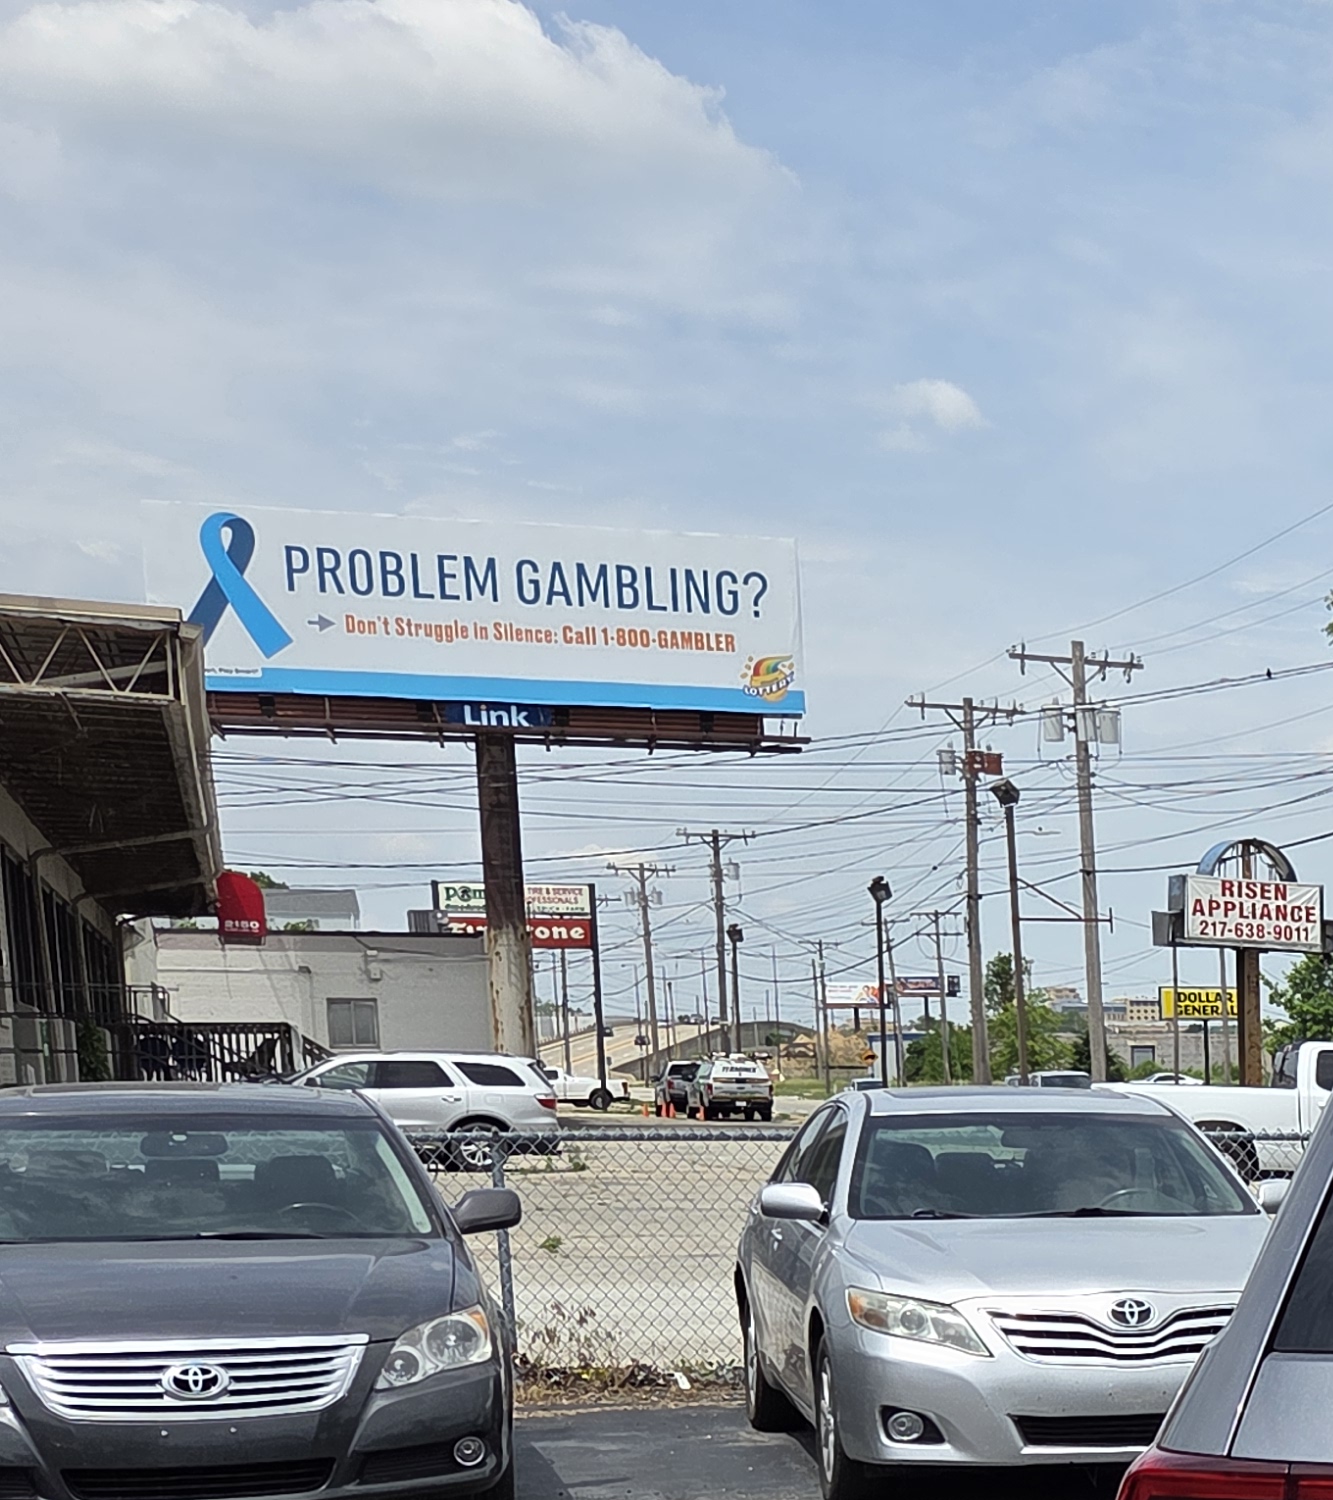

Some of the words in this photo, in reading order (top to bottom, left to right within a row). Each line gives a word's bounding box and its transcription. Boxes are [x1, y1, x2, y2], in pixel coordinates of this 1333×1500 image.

[284, 545, 499, 602] PROBLEM
[515, 559, 768, 619] GAMBLING?
[345, 614, 390, 635] Don't
[395, 617, 469, 643] Struggle
[493, 622, 558, 644] Silence:
[562, 625, 597, 645] Call
[743, 670, 795, 697] LOTTERY
[464, 704, 530, 727] Link
[1221, 879, 1288, 901] RISEN
[1192, 898, 1317, 924] APPLIANCE
[1199, 920, 1310, 942] 217-638-9011
